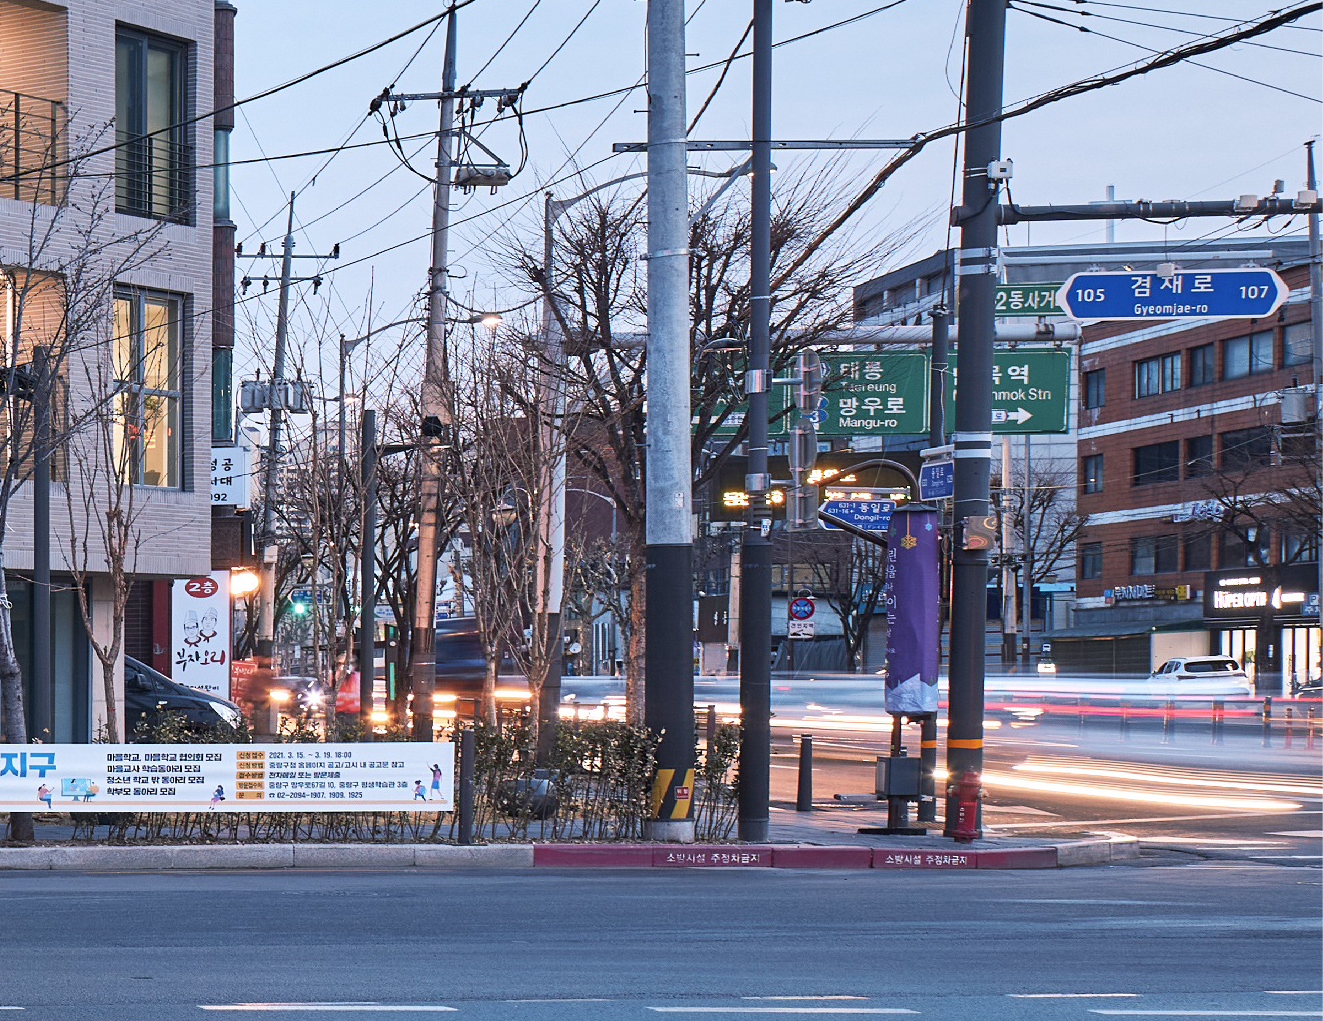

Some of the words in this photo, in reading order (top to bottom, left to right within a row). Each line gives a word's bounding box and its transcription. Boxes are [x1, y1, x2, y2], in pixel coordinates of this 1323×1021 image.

[1130, 275, 1215, 298] 겸재로
[1239, 285, 1269, 300] 107
[1076, 288, 1106, 303] 105
[1134, 303, 1209, 317] Gyeomjae-ro
[1028, 388, 1052, 401] Stn
[839, 396, 906, 416] 망우로
[839, 417, 898, 430] Mangu-ro
[858, 502, 891, 514] 동일로
[189, 581, 215, 594] 2층
[175, 648, 226, 672] 부자오리
[205, 753, 222, 762] 모집
[334, 751, 352, 759] 18:00
[184, 765, 201, 773] 모집
[132, 776, 149, 784] 학교
[187, 776, 205, 784] 모집
[159, 787, 176, 796] 모집
[666, 852, 705, 864] 소방시설
[710, 852, 760, 864] 주정차금지
[885, 855, 922, 865] 소방시설
[925, 855, 968, 866] 주정차금지
